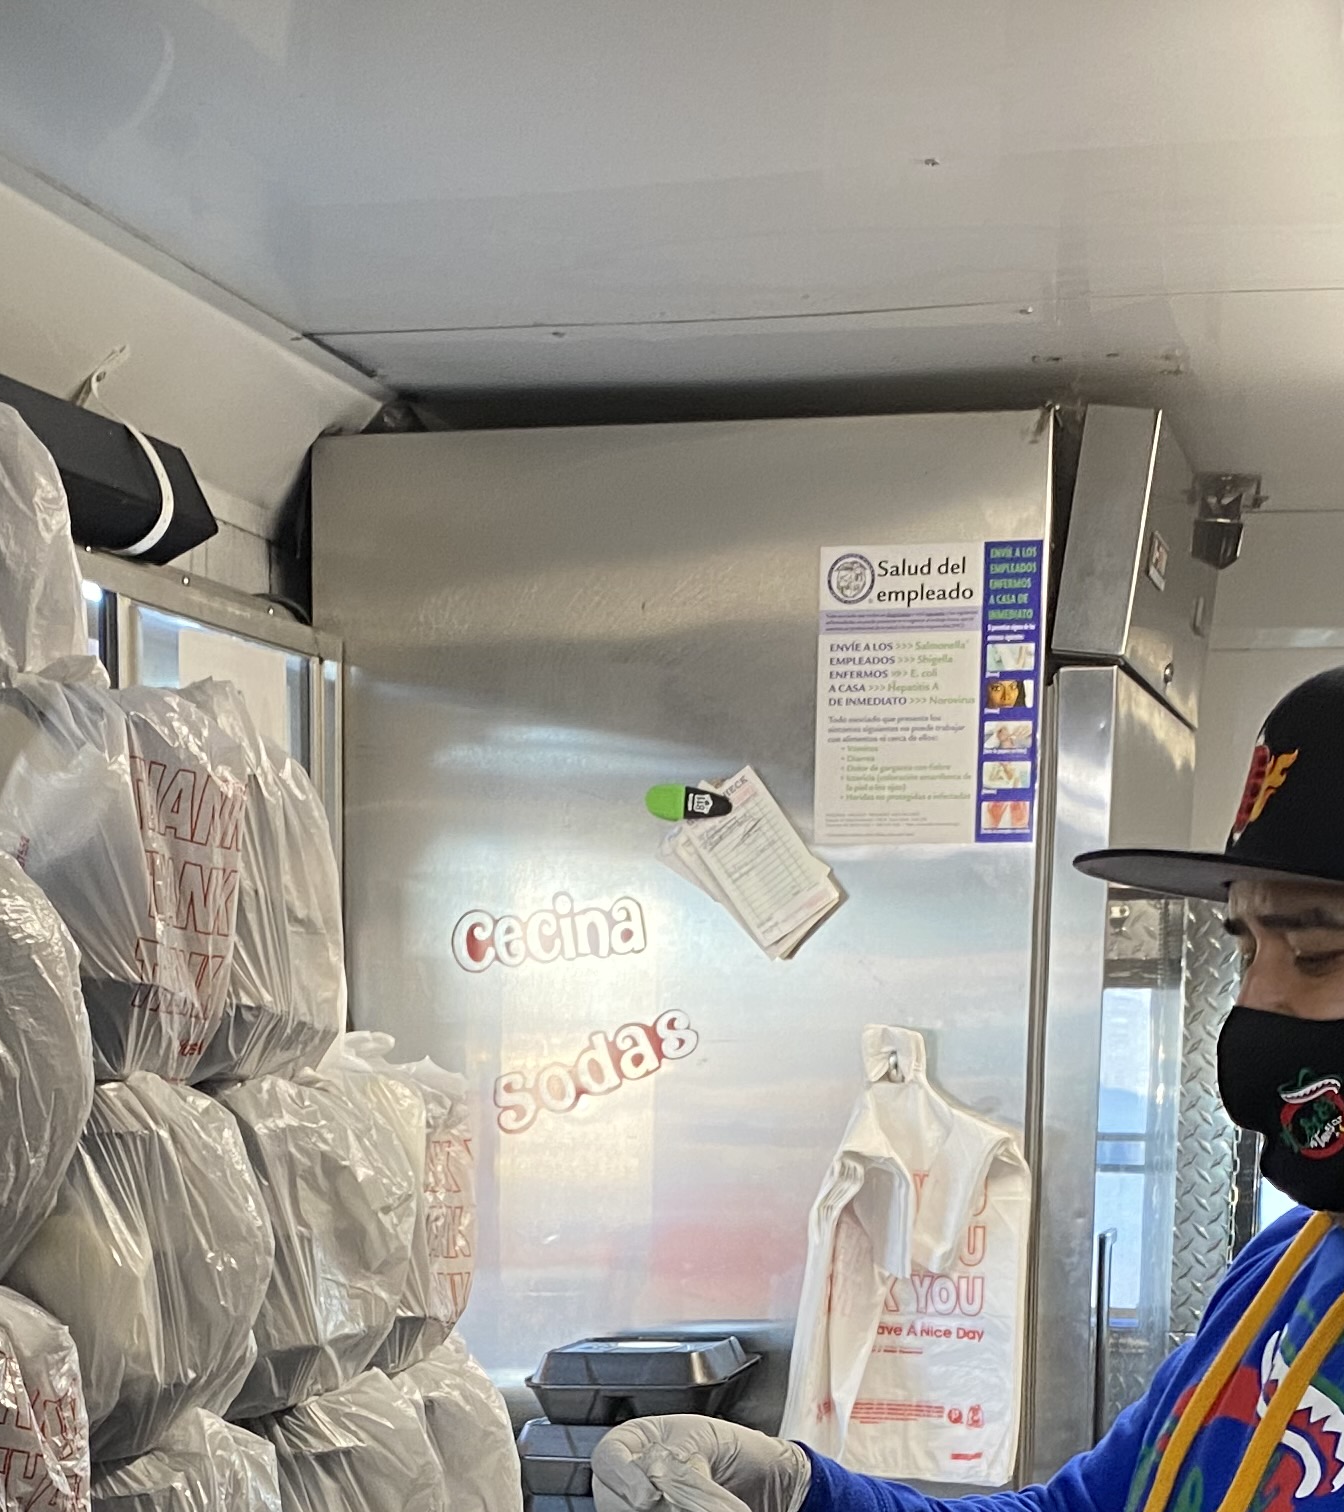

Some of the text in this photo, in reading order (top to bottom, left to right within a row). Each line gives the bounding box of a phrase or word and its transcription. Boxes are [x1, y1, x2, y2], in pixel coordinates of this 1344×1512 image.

[877, 556, 966, 577] Salud del
[876, 581, 974, 607] empleado
[829, 641, 862, 652] ENVÍE
[862, 643, 871, 652] A
[872, 642, 894, 652] LOS
[829, 654, 953, 666] EMPLEADOS Shigella
[829, 669, 889, 680] ENFERMOS
[828, 684, 837, 693] A
[838, 683, 866, 693] CASA
[828, 697, 845, 707] DE
[845, 696, 907, 707] INMEDIATO
[910, 1273, 985, 1317] YOU
[876, 1322, 985, 1343] ave A Nice Day
